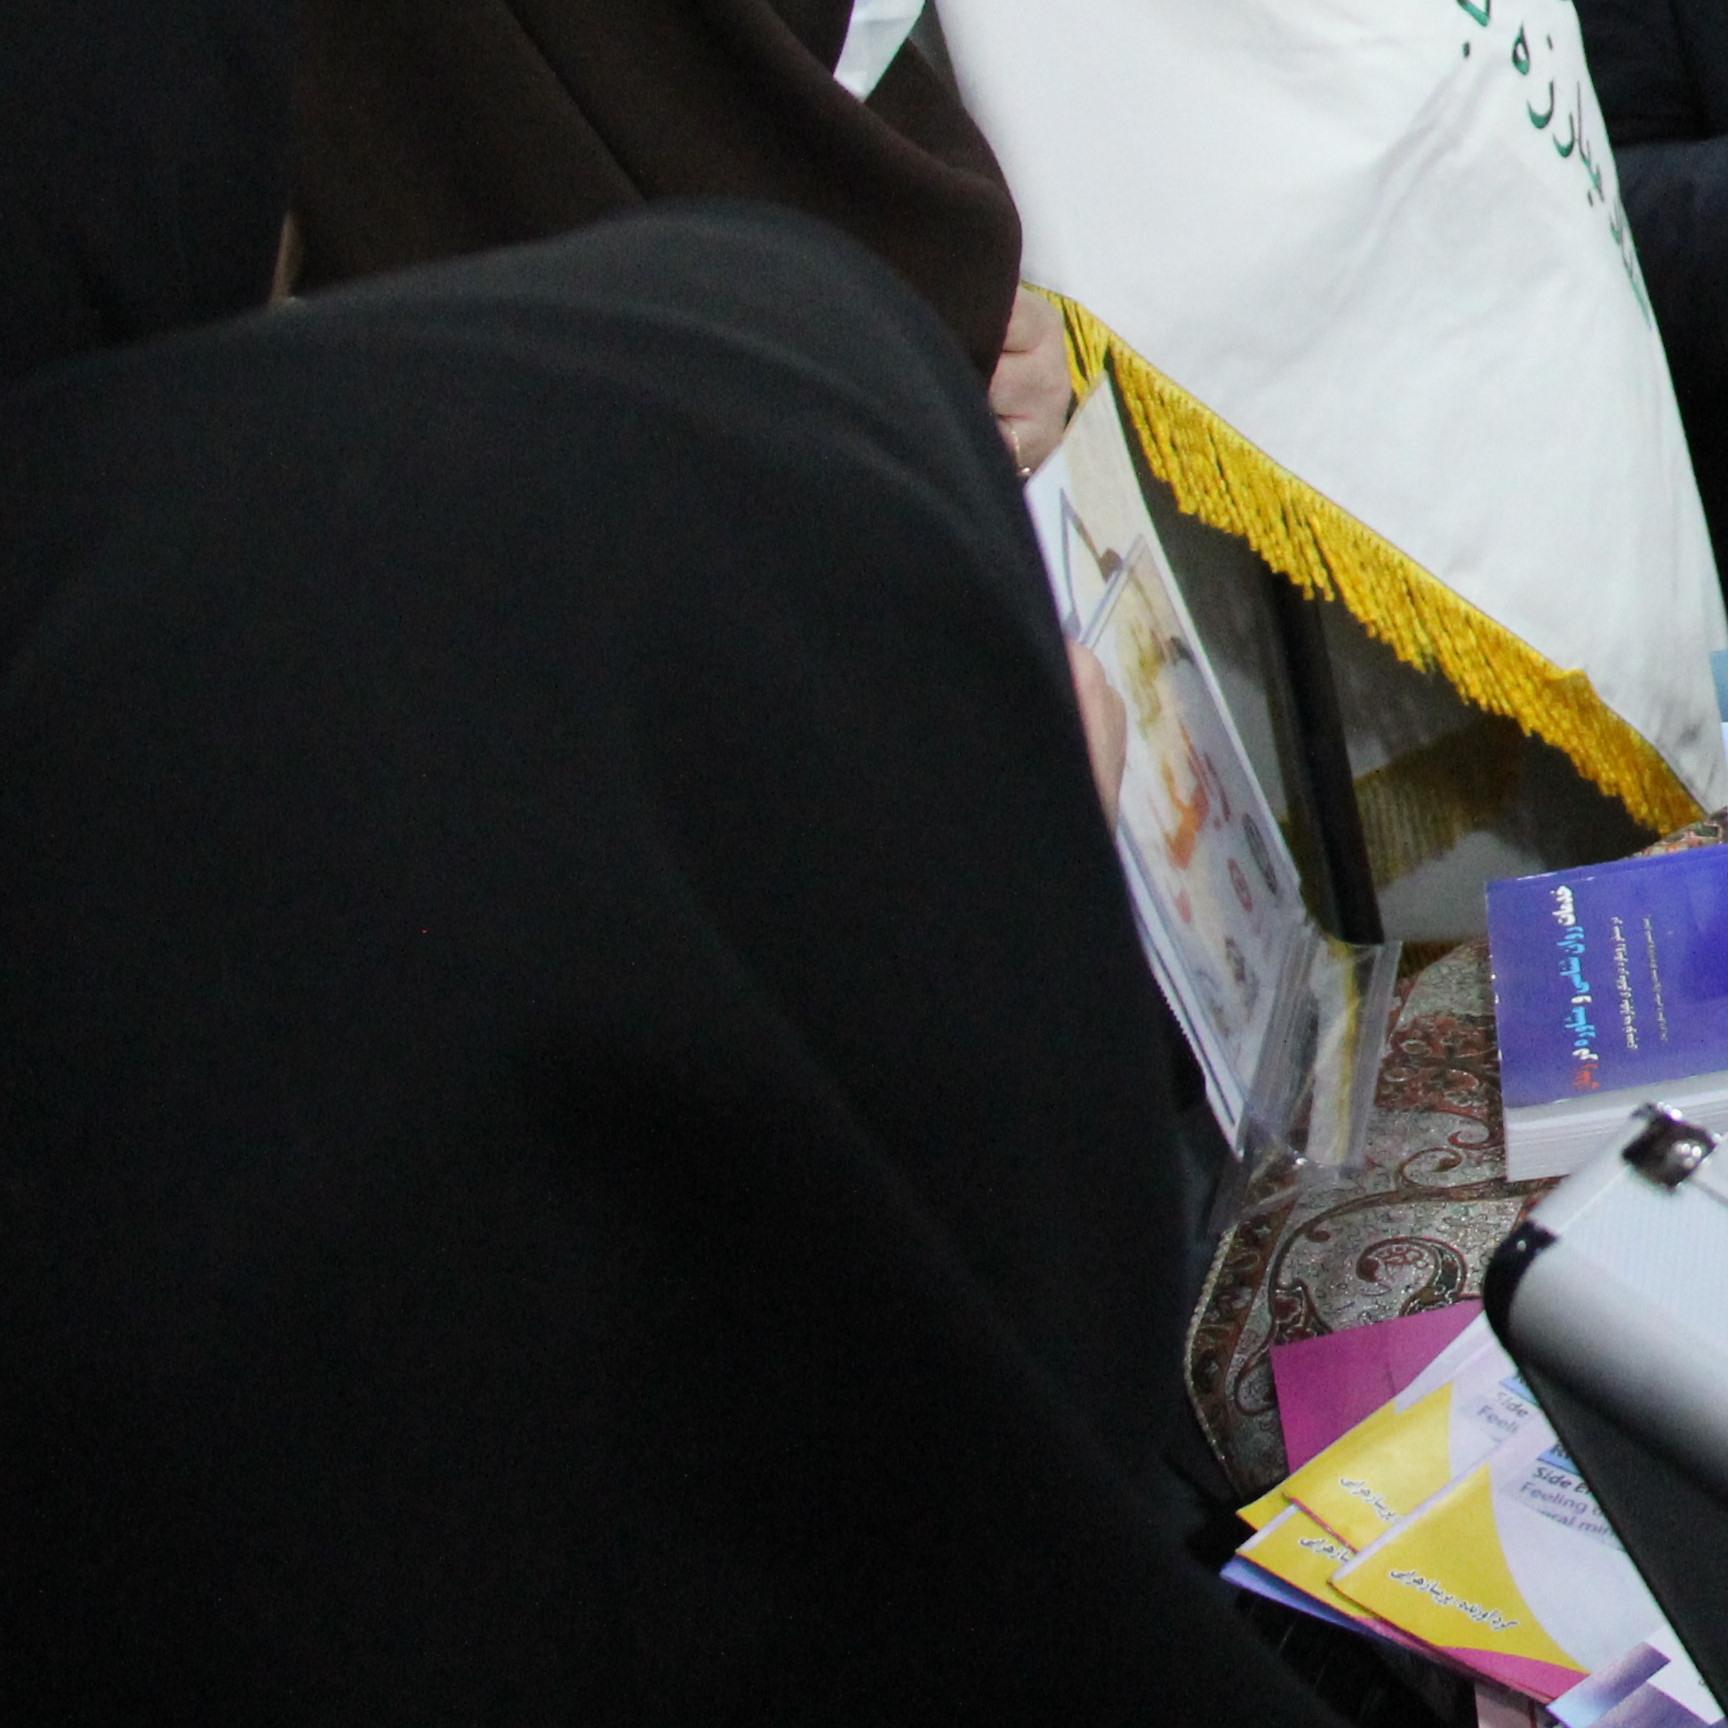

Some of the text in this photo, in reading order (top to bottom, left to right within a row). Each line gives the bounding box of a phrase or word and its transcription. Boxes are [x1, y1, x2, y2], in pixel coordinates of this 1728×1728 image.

[1550, 885, 1576, 927] خدمات
[1572, 1048, 1599, 1060] در
[1532, 1466, 1572, 1488] Side
[1520, 1481, 1588, 1516] Feeling
